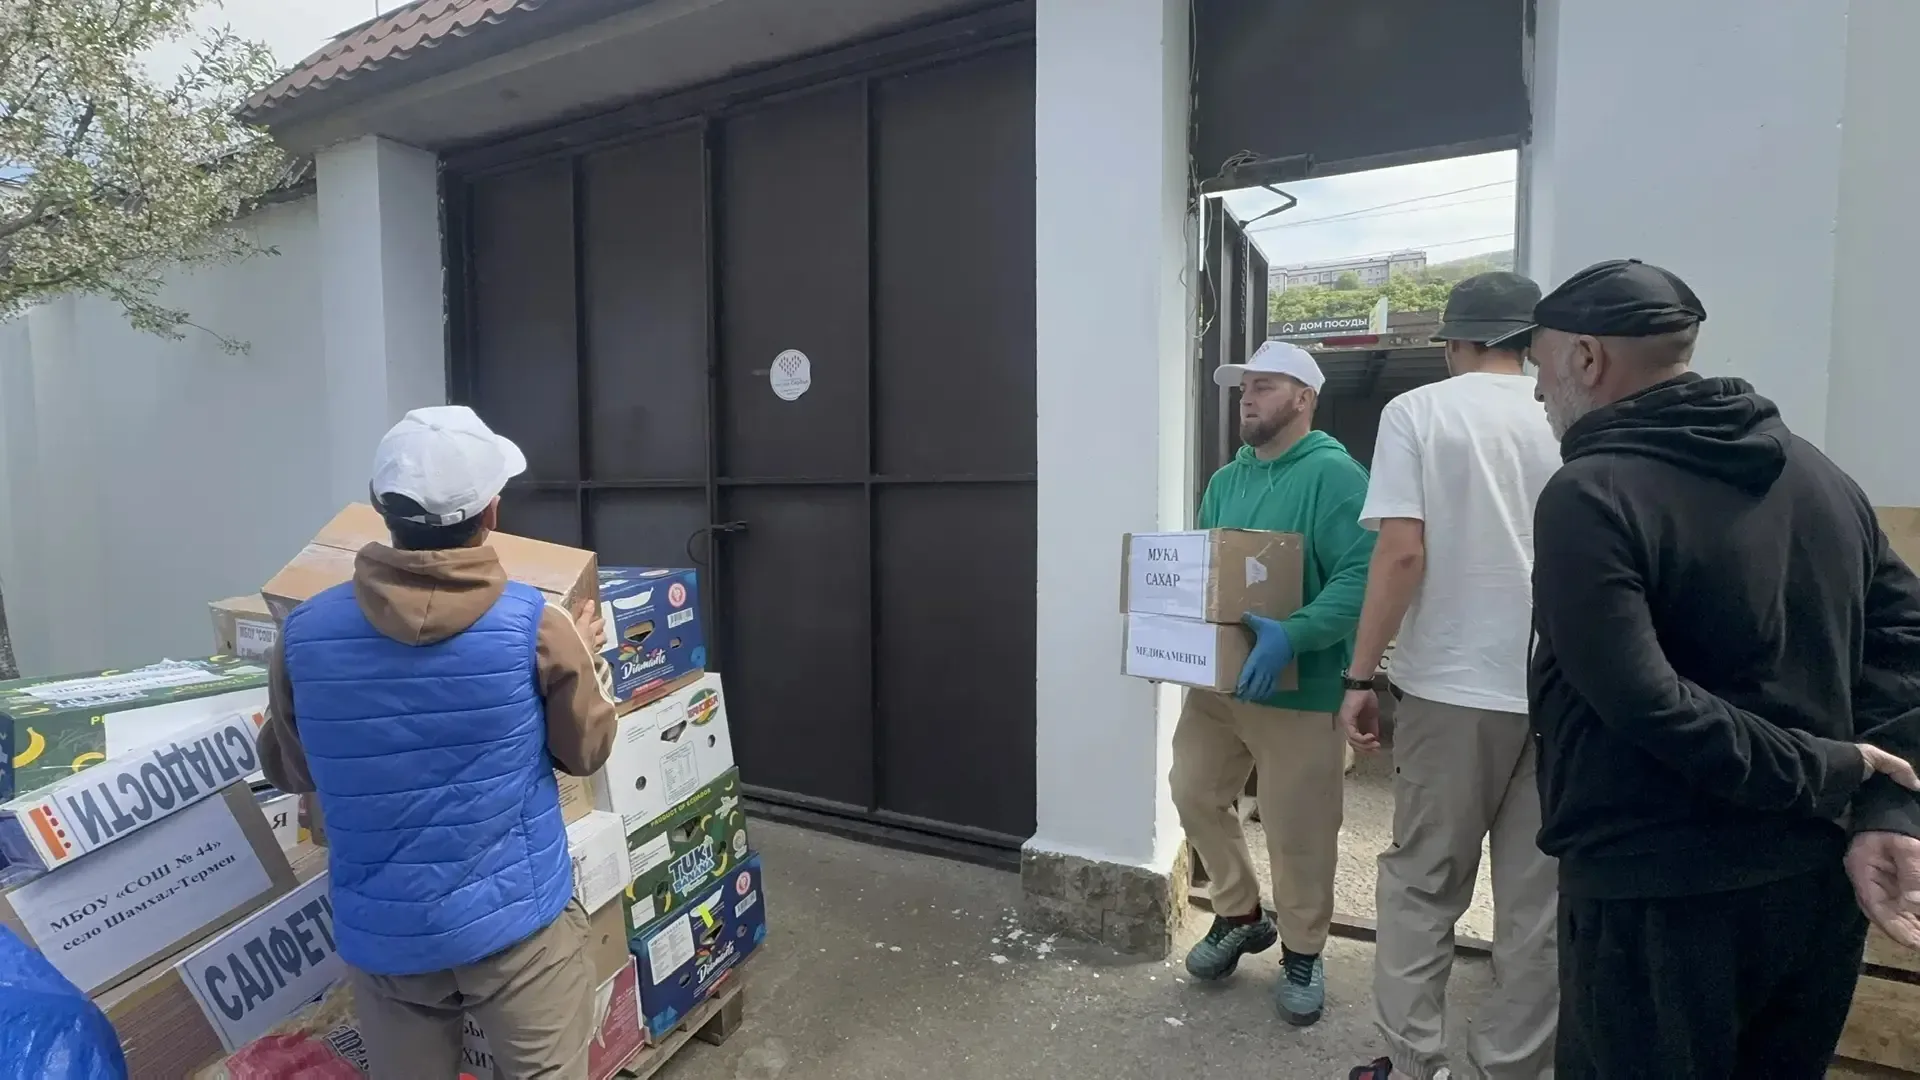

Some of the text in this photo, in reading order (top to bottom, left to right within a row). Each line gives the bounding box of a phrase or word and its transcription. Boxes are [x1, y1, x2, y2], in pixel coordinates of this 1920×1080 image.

[1300, 318, 1368, 331] ДОМ ПОСУДЫ
[1147, 548, 1179, 562] МУКА
[1145, 572, 1181, 588] САХАР
[1135, 645, 1207, 667] МЕДИКАМЕНТЫ
[66, 725, 256, 846] СЛАДОСТИ
[668, 843, 713, 882] TUKI
[50, 840, 222, 933] МБОУ «СОШ № 44»
[63, 853, 236, 951] село Шамхал-Термен
[204, 894, 338, 1021] САЛФЕТ
